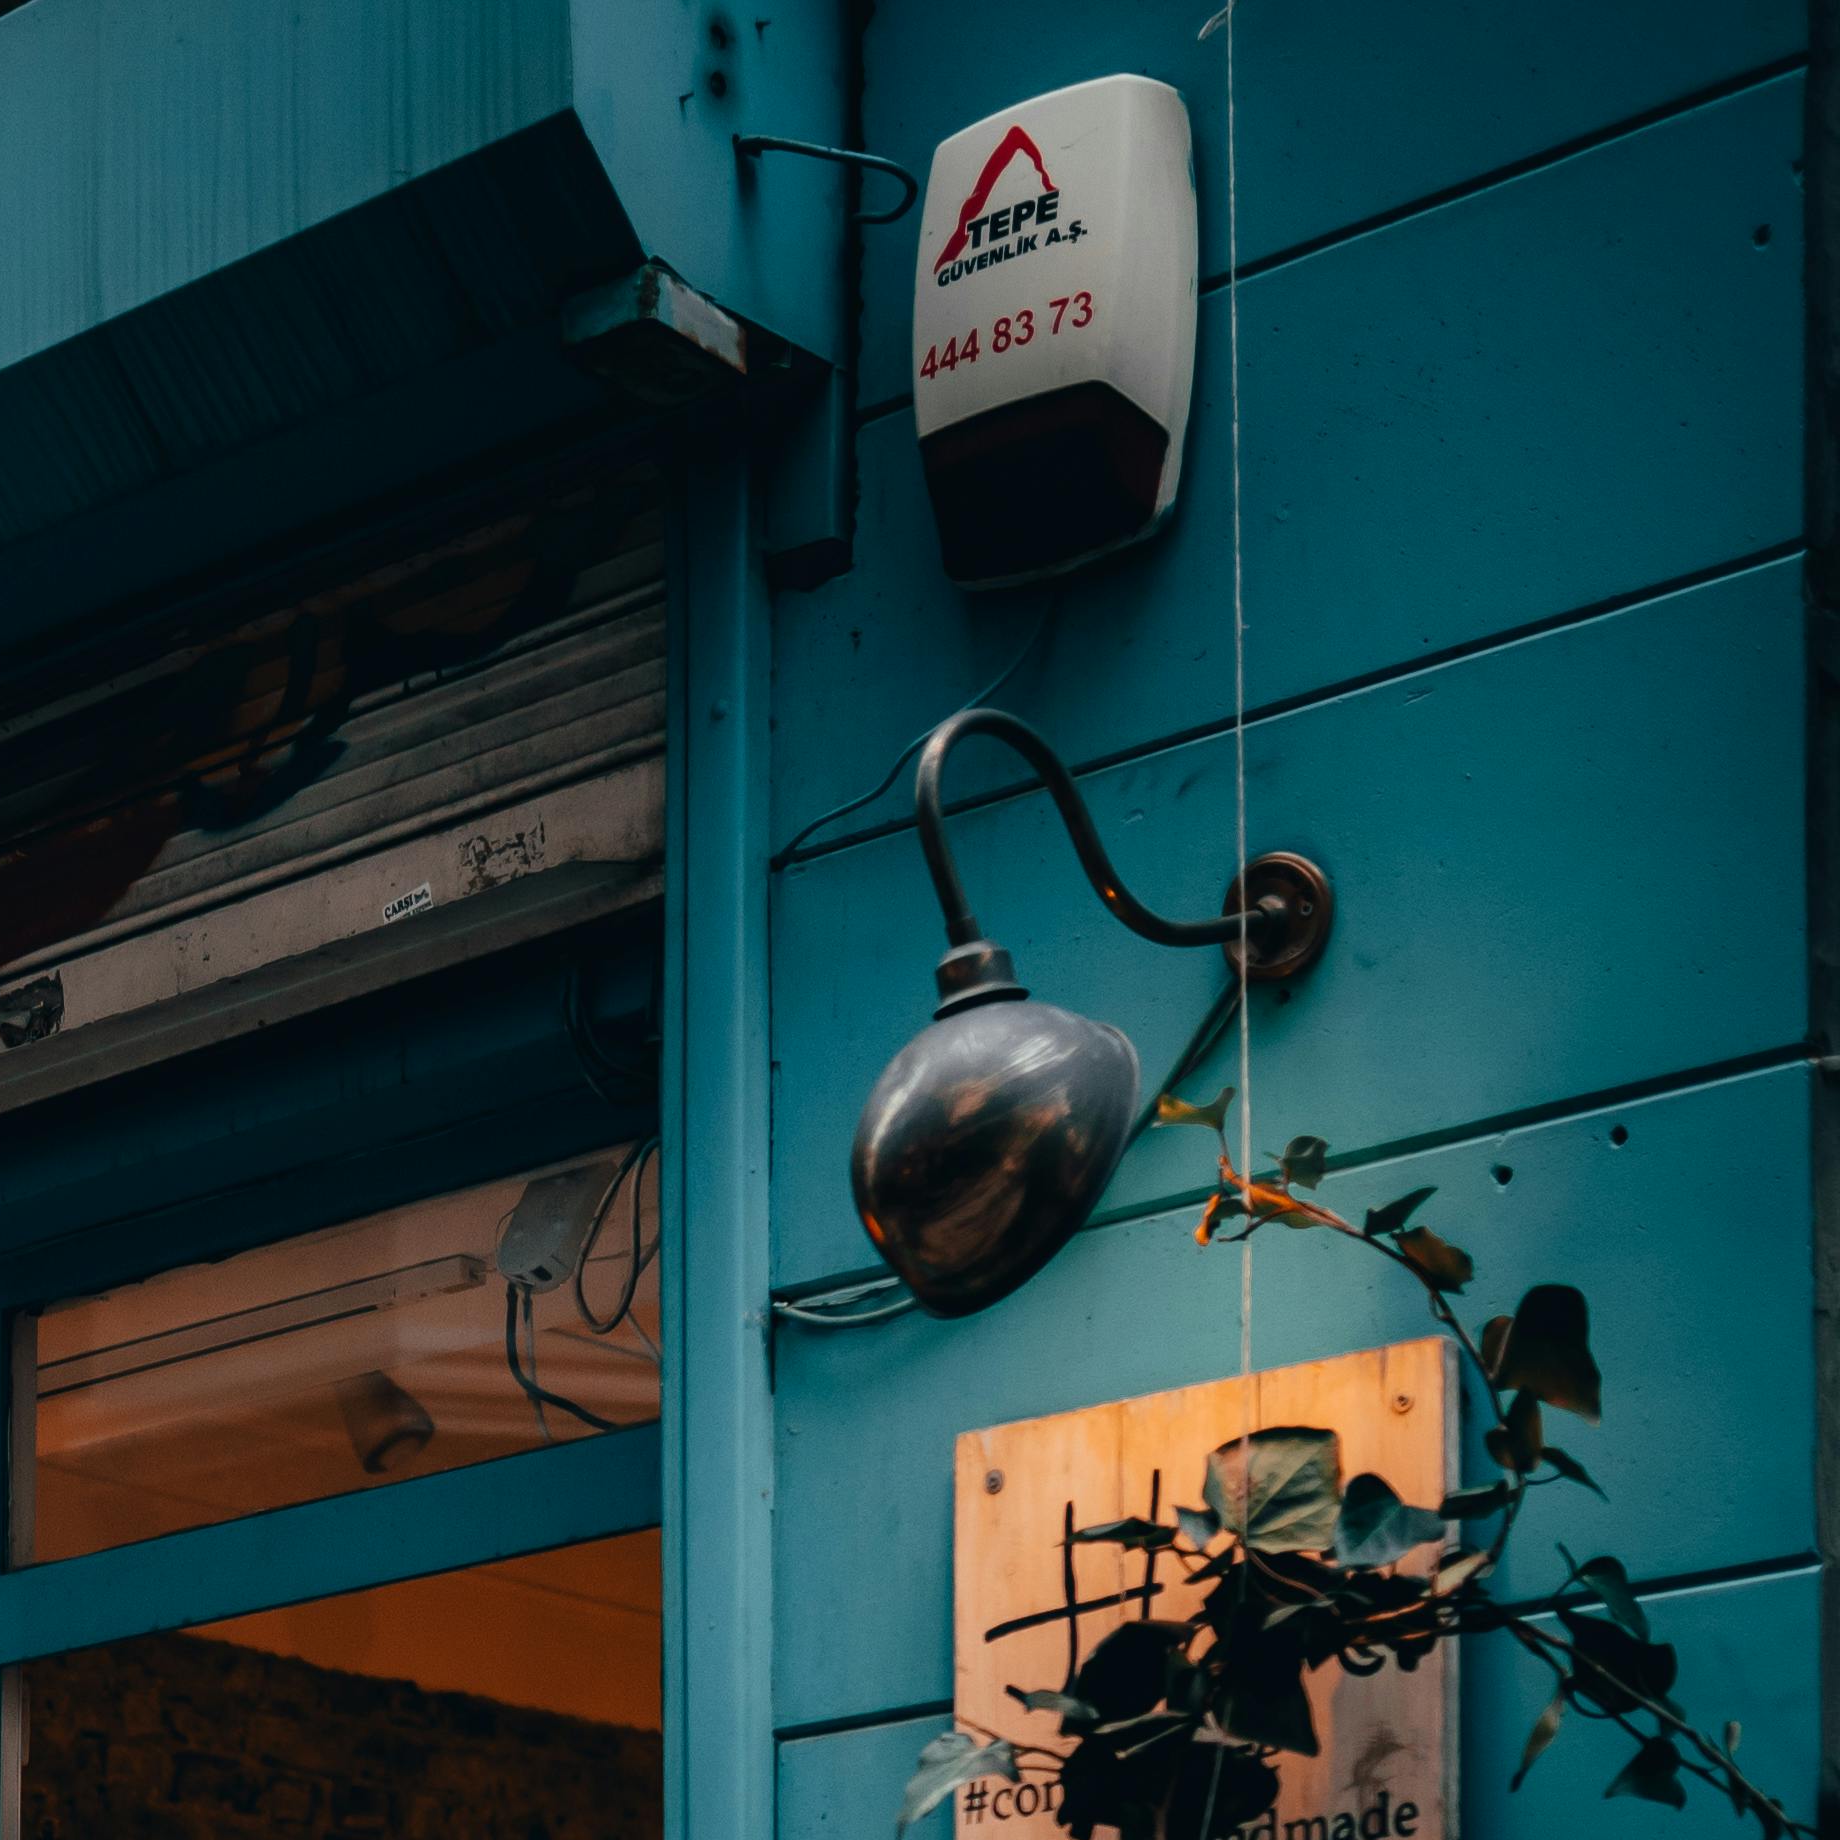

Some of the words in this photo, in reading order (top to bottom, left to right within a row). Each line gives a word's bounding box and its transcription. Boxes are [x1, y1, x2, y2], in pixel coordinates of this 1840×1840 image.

[937, 233, 1037, 287] GÜVENLİK
[1046, 220, 1088, 247] A.Ş.
[966, 190, 1060, 250] TEPE
[920, 328, 980, 381] 444
[992, 309, 1034, 354] 83
[1049, 291, 1094, 336] 73
